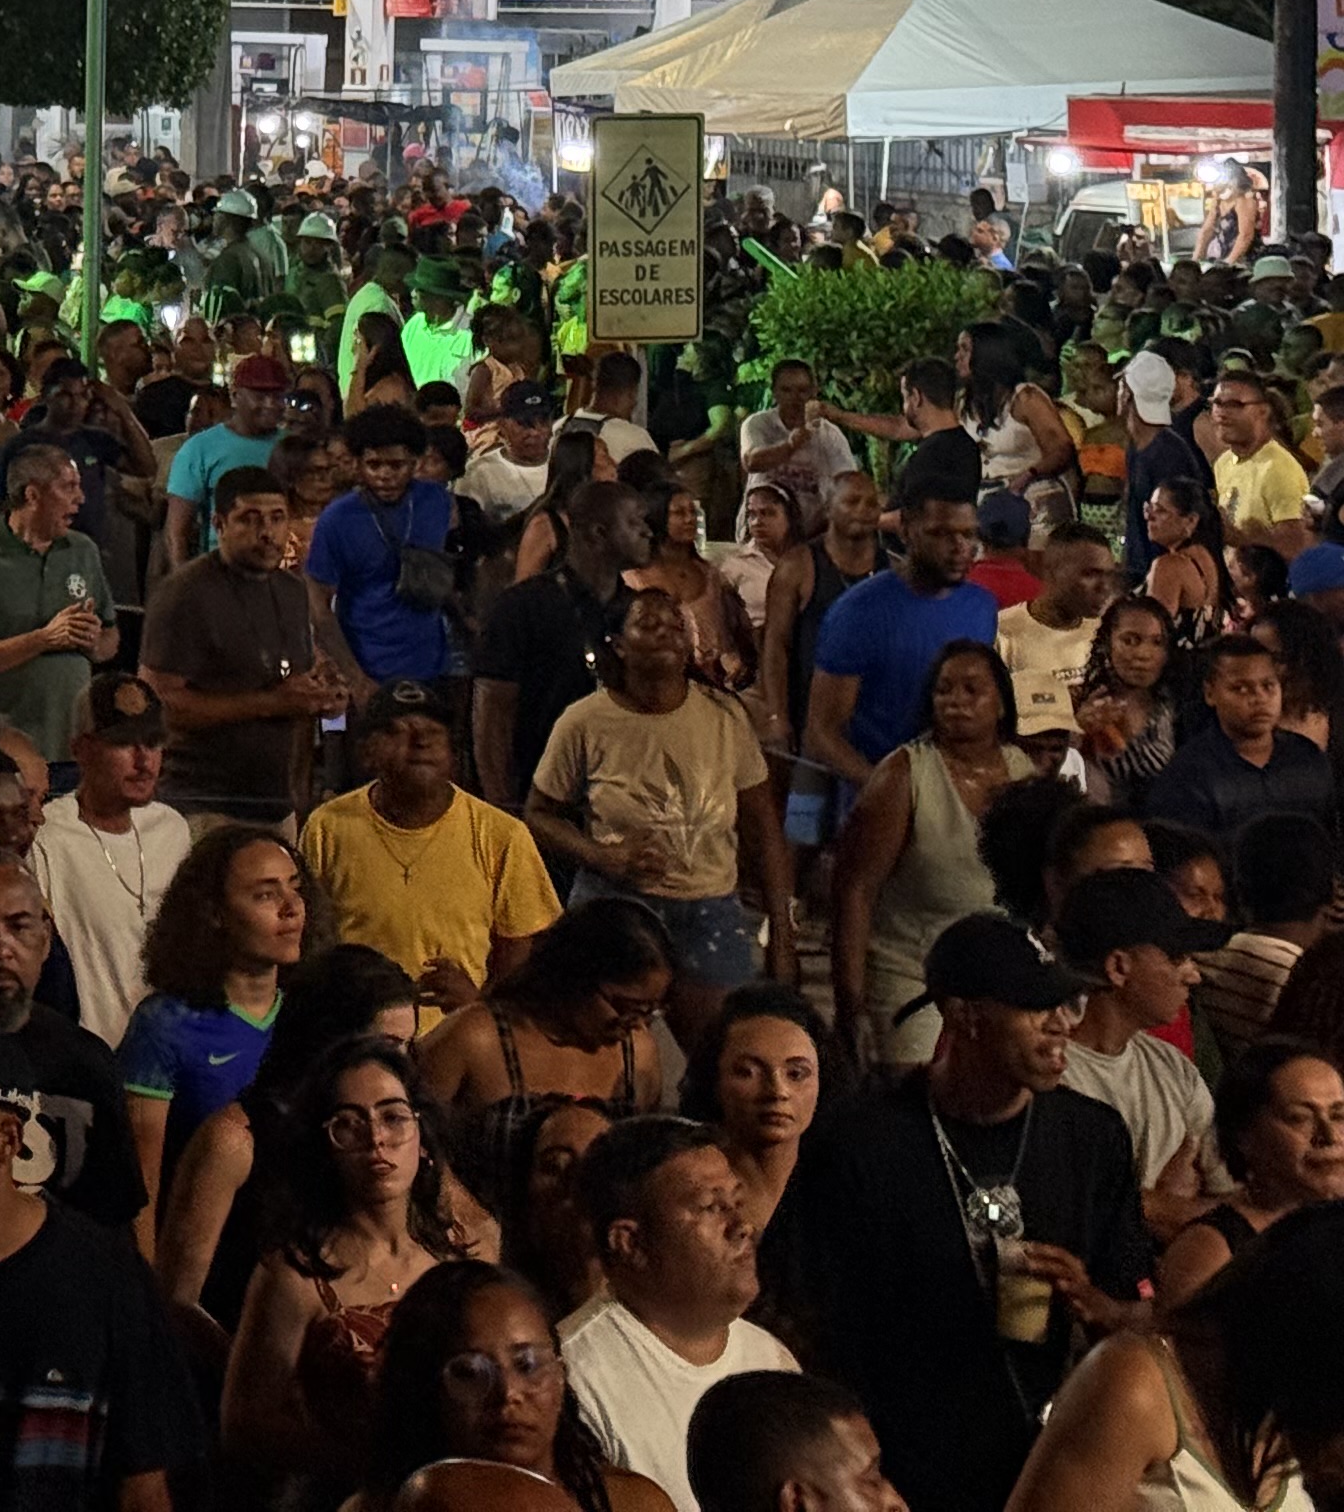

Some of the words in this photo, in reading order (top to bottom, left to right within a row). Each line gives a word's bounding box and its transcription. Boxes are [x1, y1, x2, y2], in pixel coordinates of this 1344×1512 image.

[598, 239, 696, 258] PASSAGEM
[634, 264, 661, 282] DE
[598, 288, 696, 306] ESCOLARES
